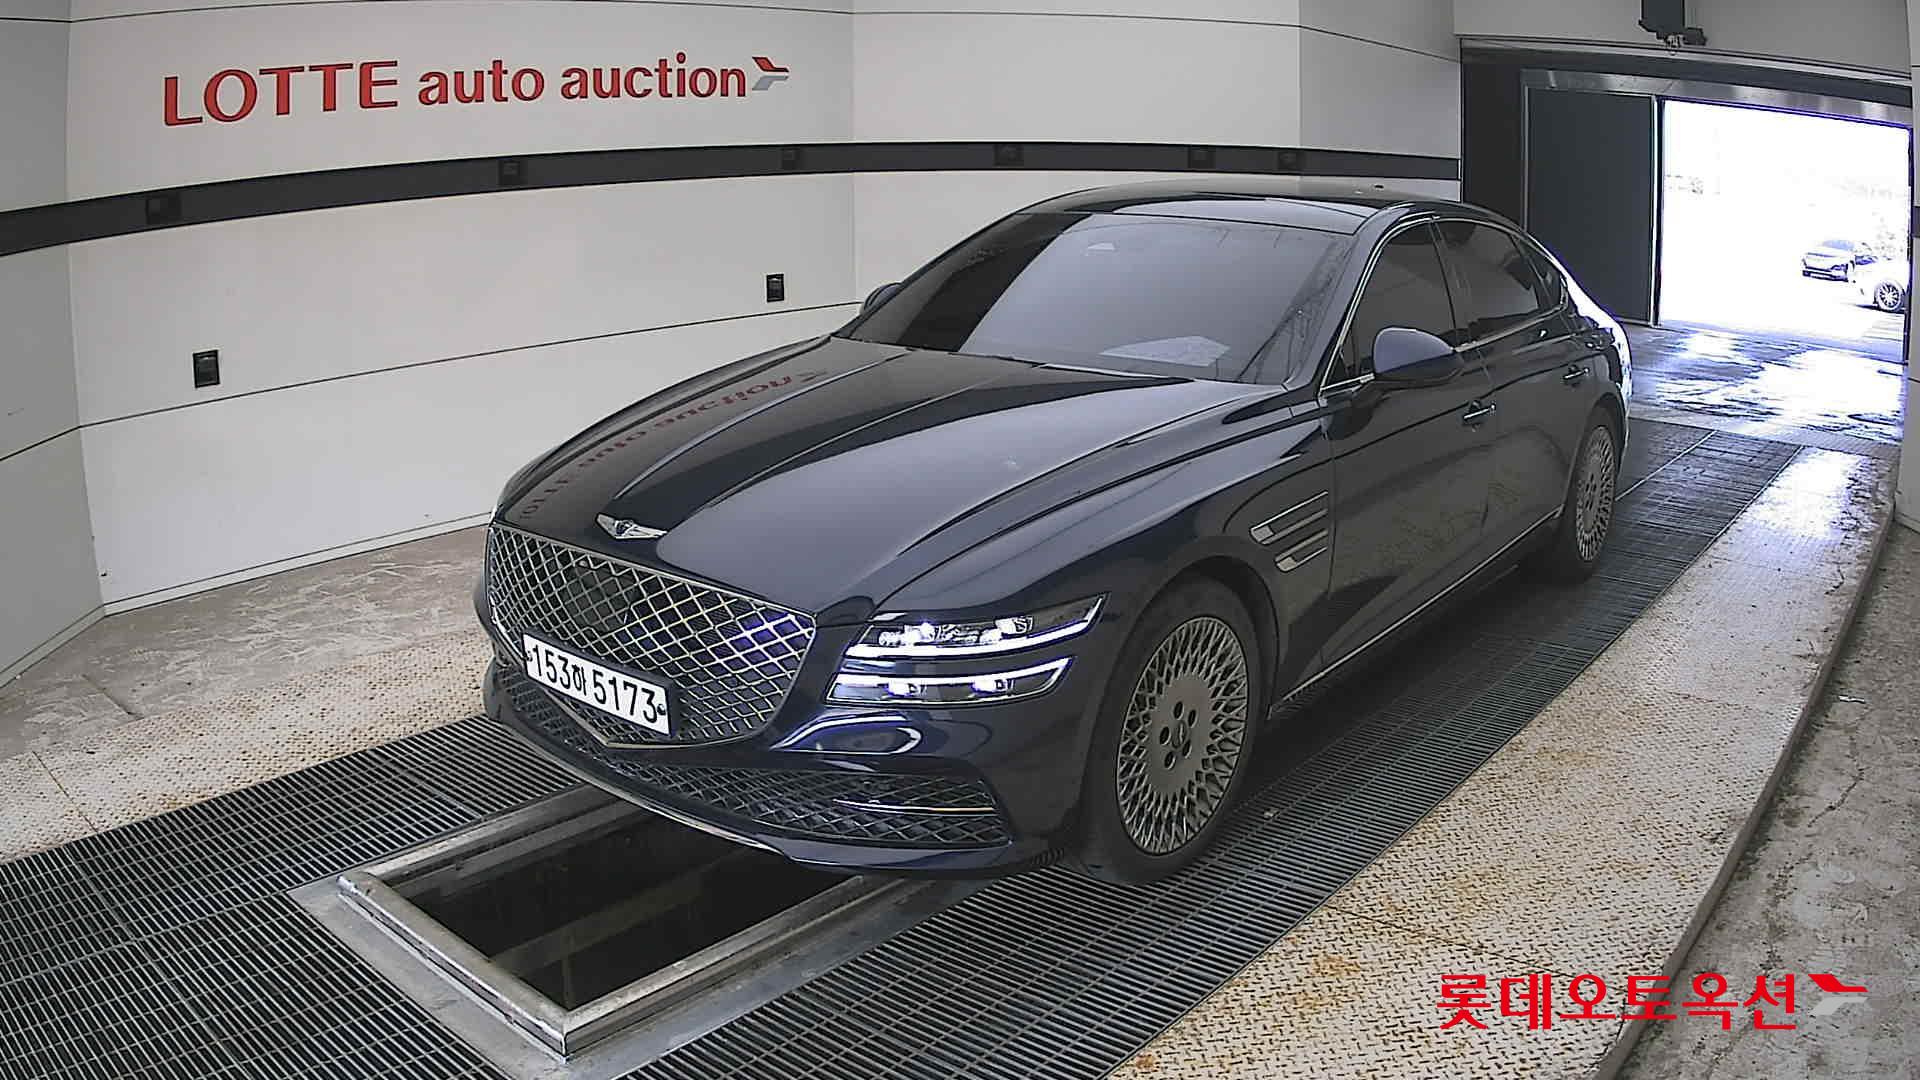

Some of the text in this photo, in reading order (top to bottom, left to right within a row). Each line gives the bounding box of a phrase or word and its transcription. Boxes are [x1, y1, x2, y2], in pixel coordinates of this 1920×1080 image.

[164, 52, 747, 126] LOTTE auto auction
